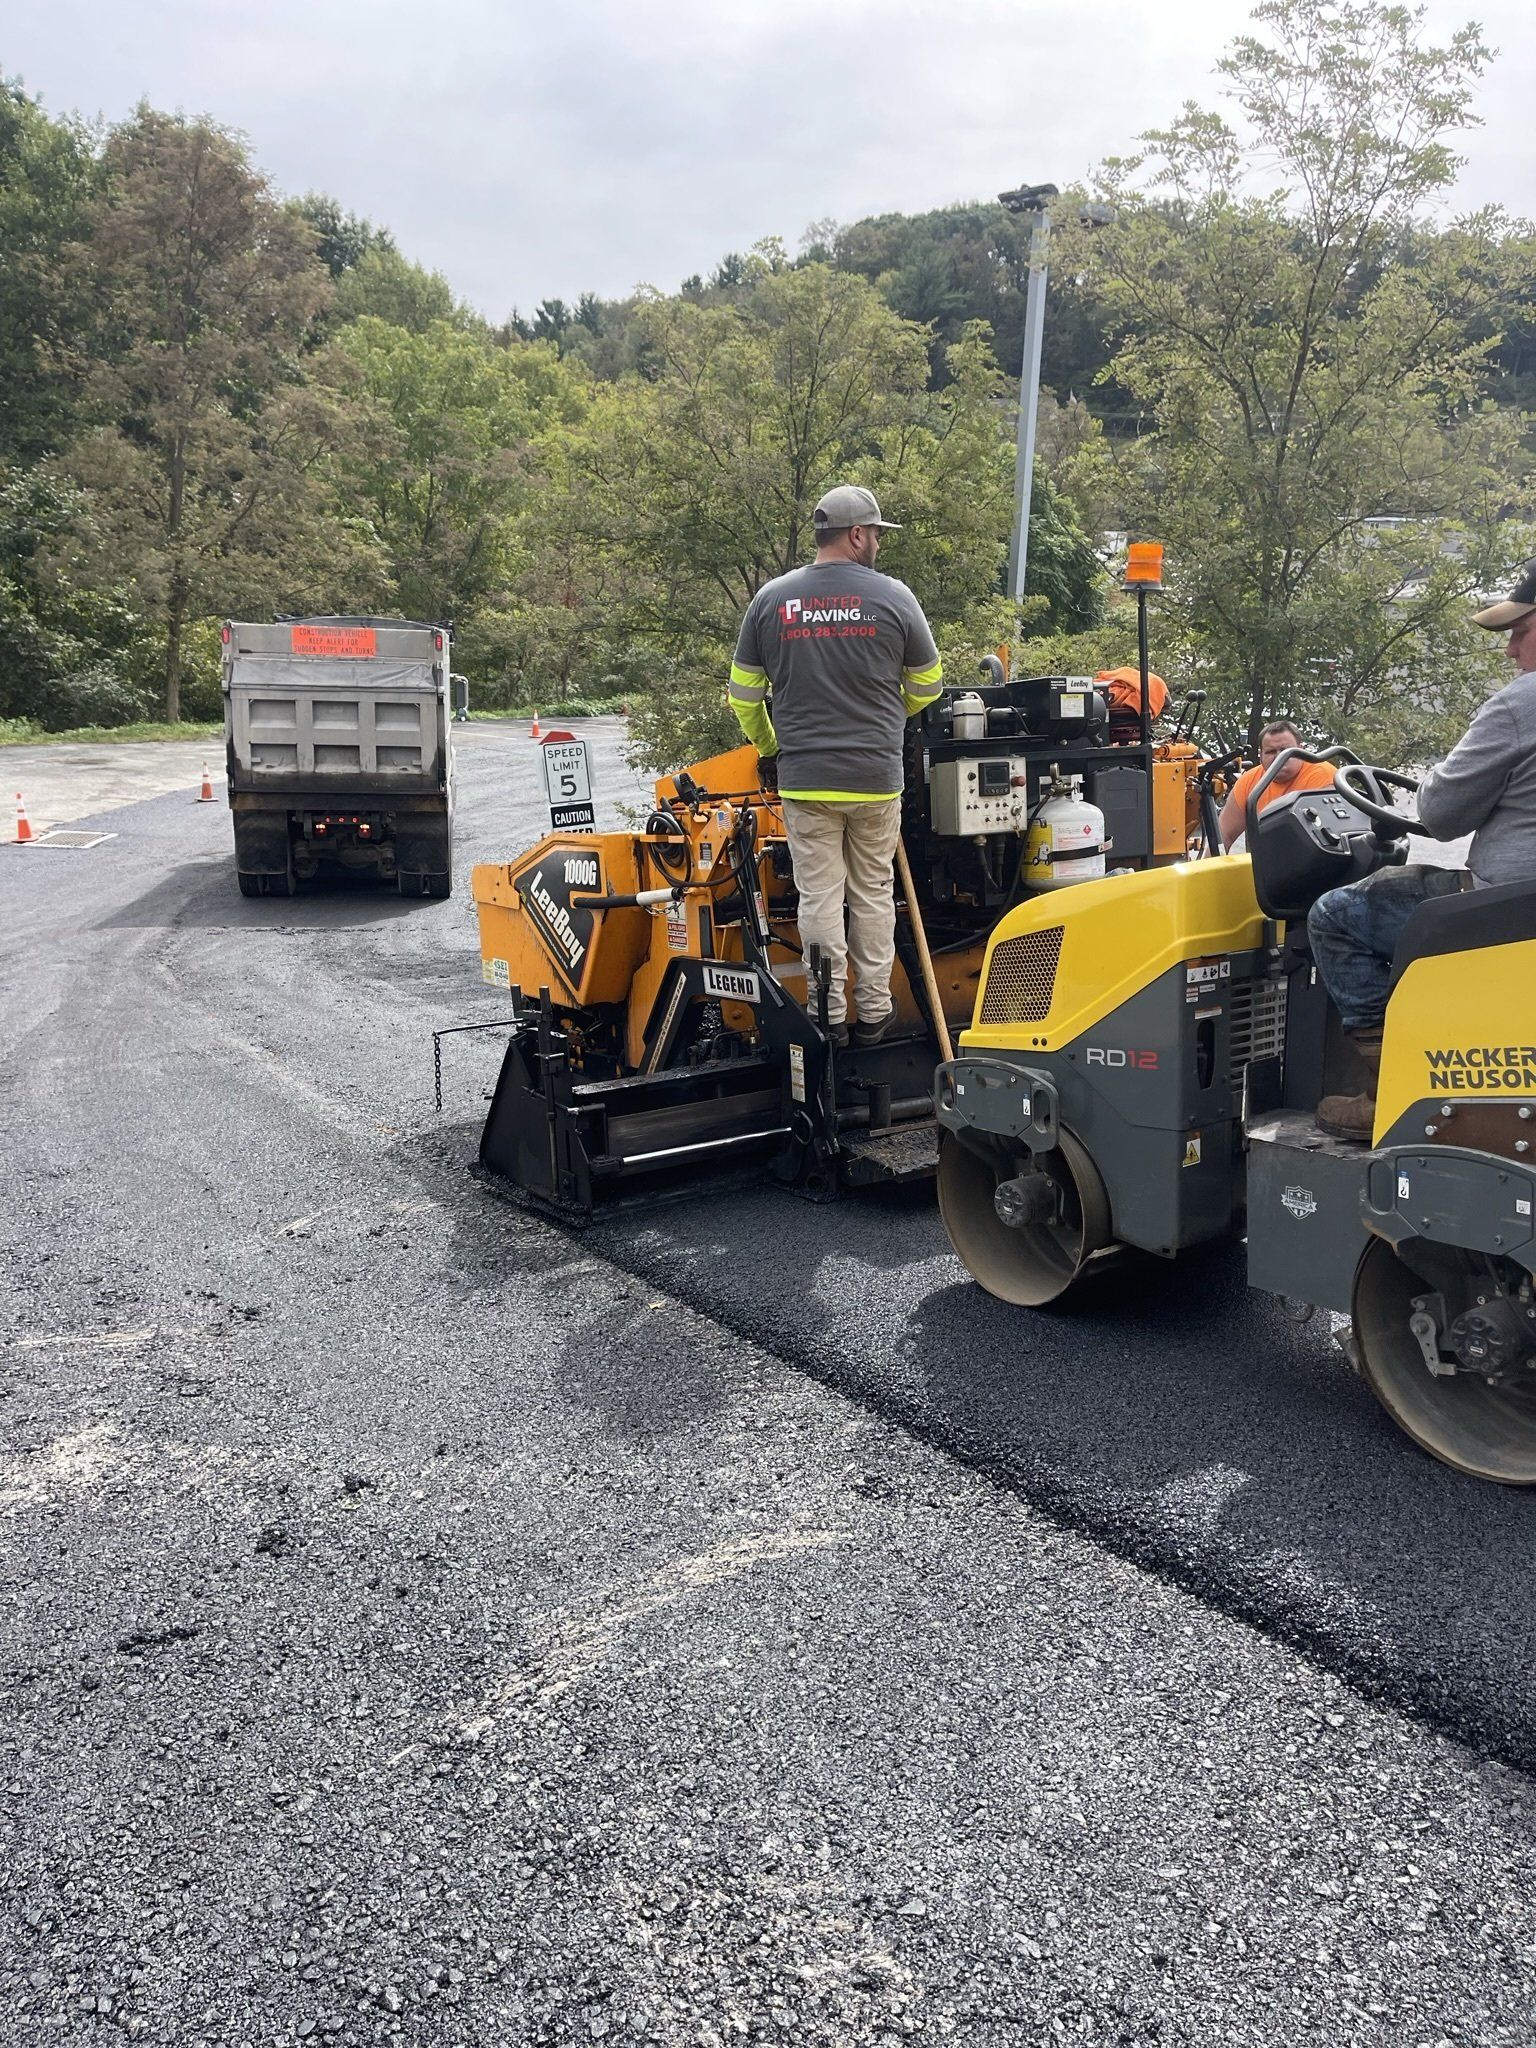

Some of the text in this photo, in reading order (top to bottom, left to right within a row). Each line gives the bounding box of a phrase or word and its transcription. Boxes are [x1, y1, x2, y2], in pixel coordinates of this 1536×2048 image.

[802, 595, 862, 609] UNITED
[802, 608, 861, 622] PAVING
[345, 630, 368, 638] VEHICLE
[294, 645, 316, 653] SUDDEN
[355, 647, 374, 655] TURNS
[548, 747, 583, 759] SPEED
[553, 760, 580, 772] LIMIT
[561, 774, 577, 796] 5
[554, 809, 592, 825] CAUTION
[563, 859, 597, 886] 1000G
[530, 870, 586, 969] LeeBoy
[708, 968, 754, 995] LEGEND
[1086, 1047, 1160, 1070] RD12
[1424, 1046, 1536, 1069] WACKER
[1429, 1068, 1536, 1089] NEUSON
